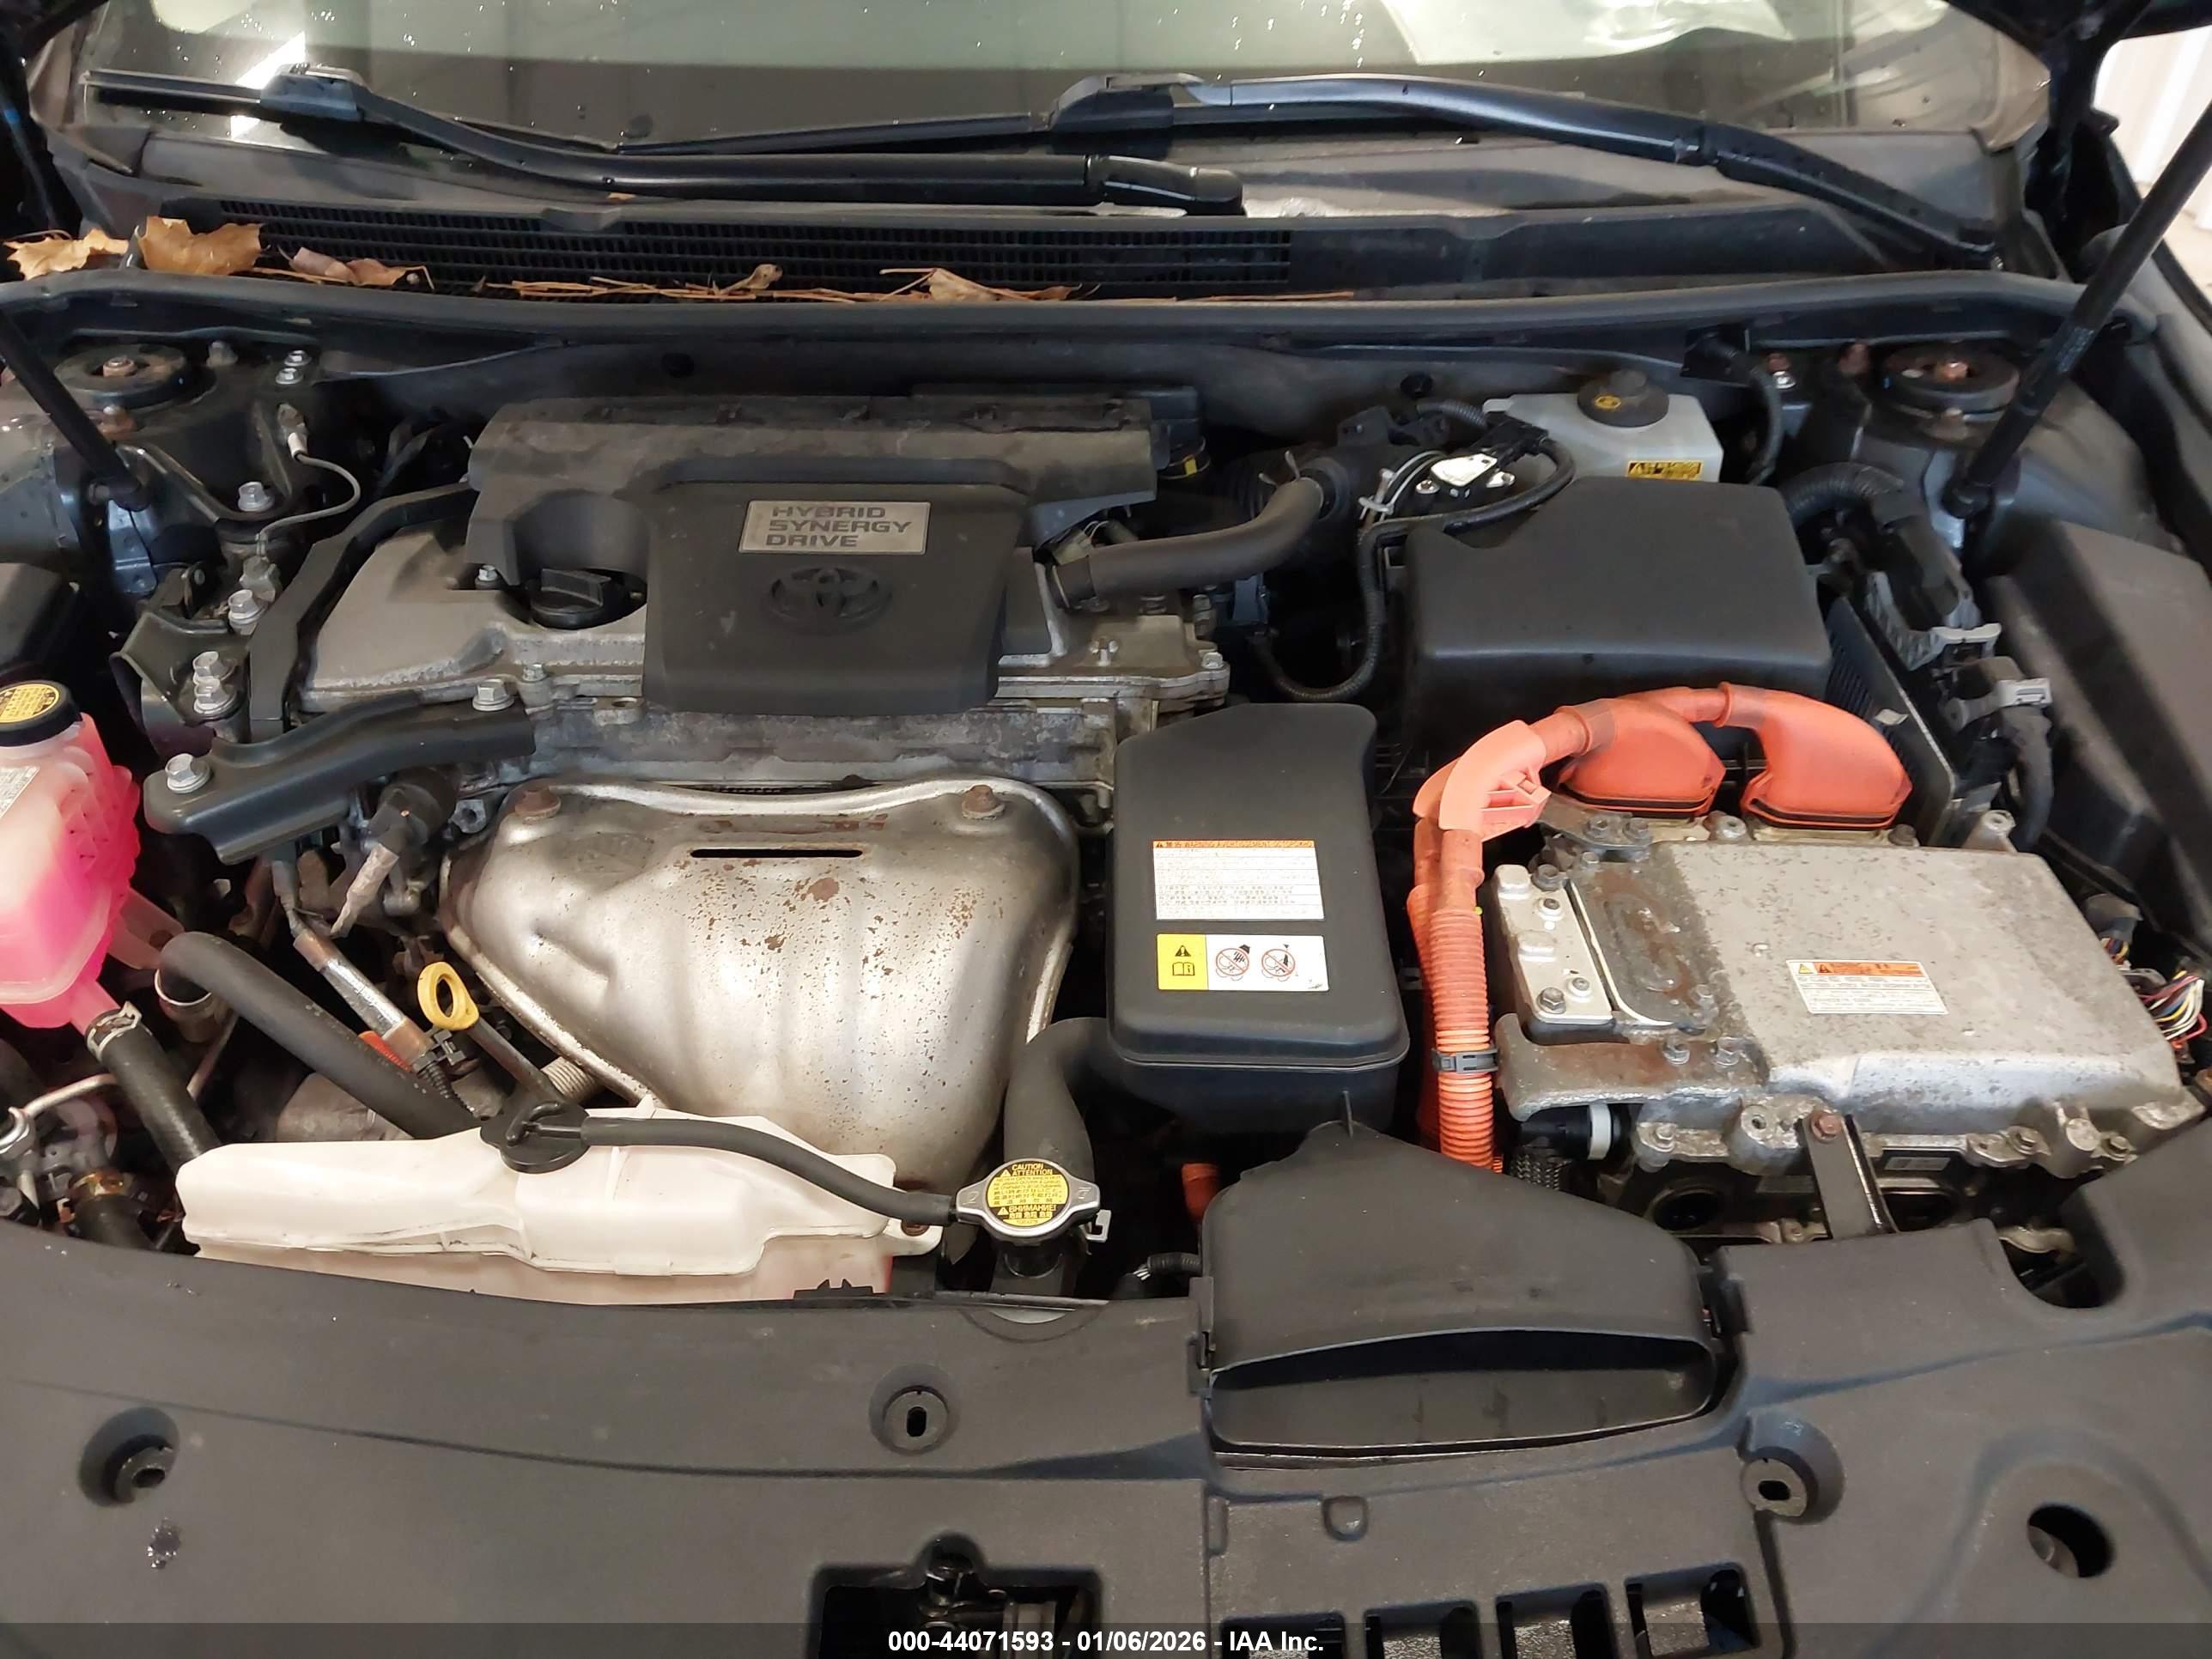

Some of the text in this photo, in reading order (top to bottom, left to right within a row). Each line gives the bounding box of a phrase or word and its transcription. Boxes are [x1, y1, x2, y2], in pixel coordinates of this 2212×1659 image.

[772, 506, 886, 519] HYBRID
[769, 520, 912, 533] SYNERGY
[766, 534, 858, 547] DRIVE
